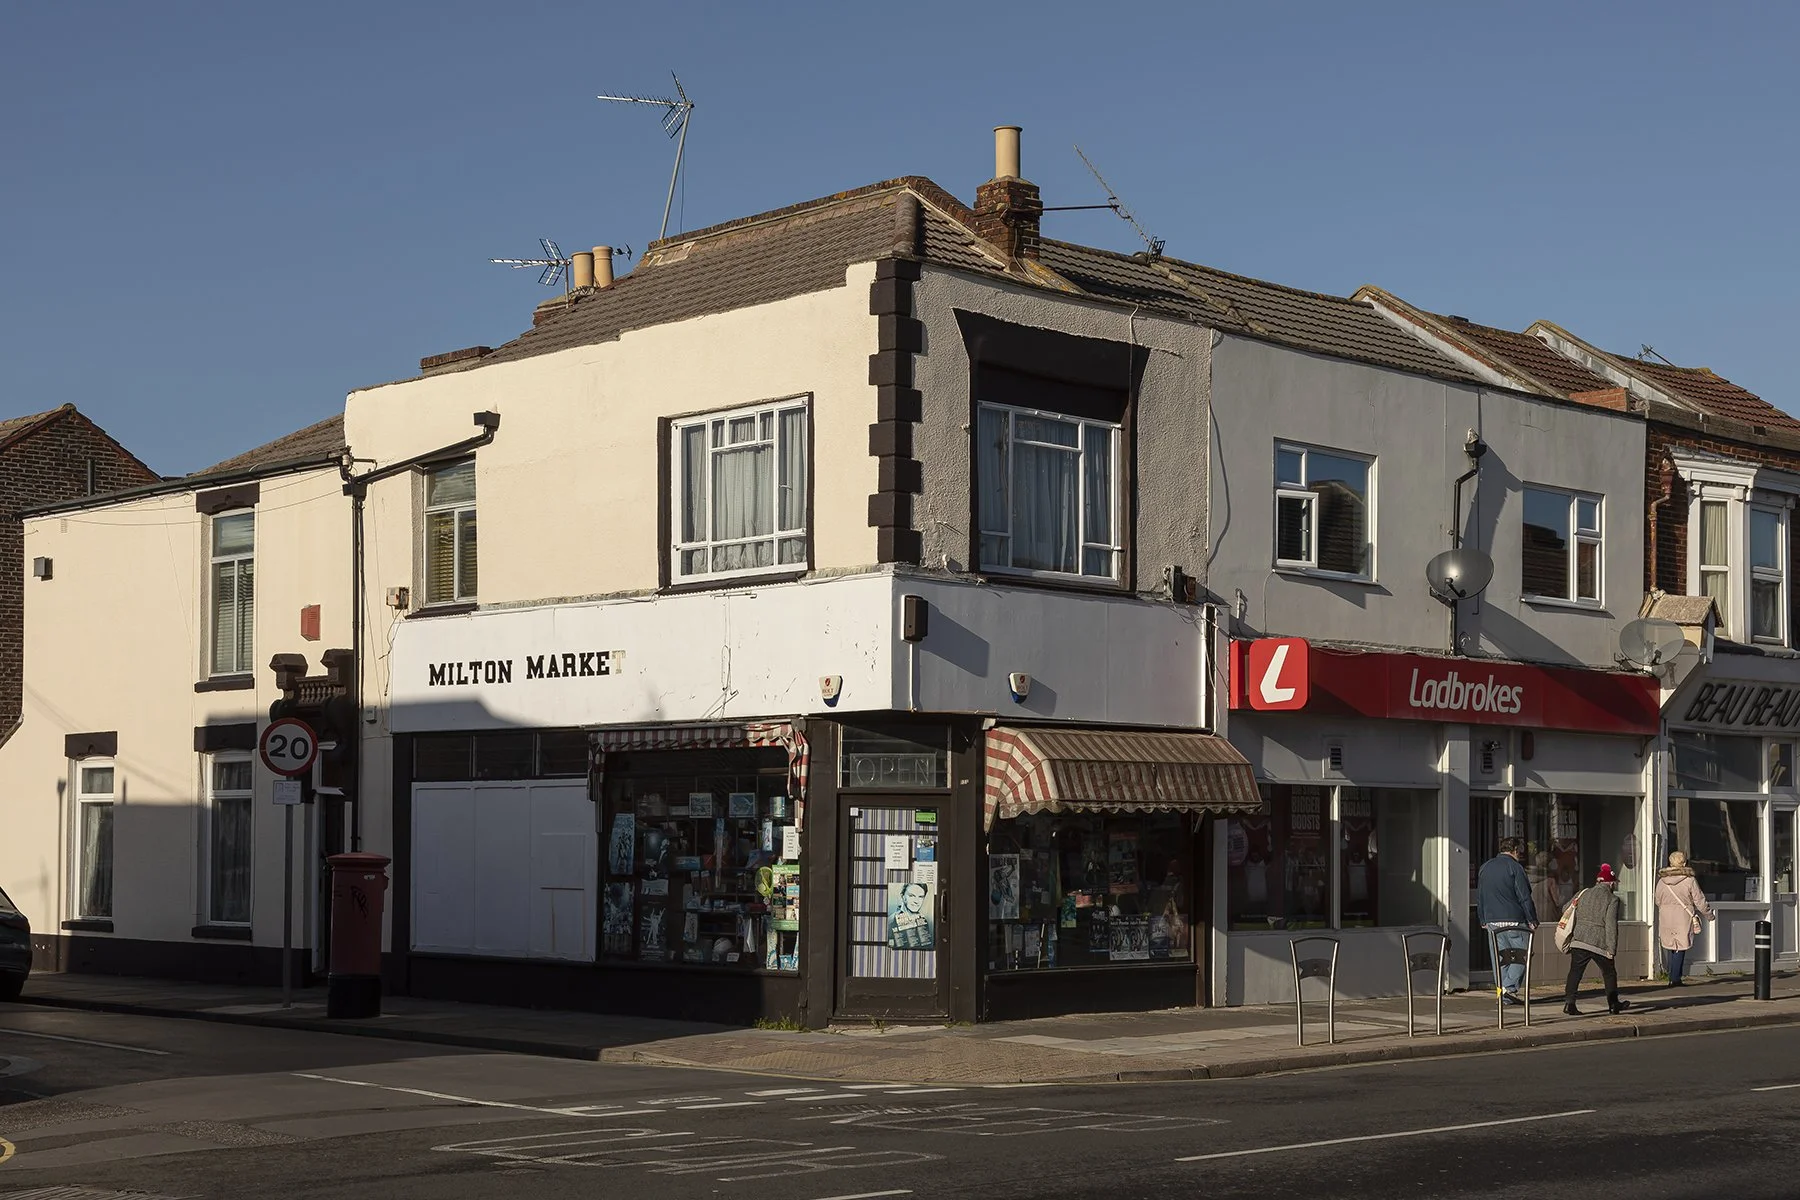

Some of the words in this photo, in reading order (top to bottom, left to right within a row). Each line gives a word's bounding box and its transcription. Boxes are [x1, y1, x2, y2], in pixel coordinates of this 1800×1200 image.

[428, 659, 513, 687] MILTON
[526, 649, 626, 680] MARKET
[1409, 667, 1523, 715] Ladbrokes
[1684, 682, 1755, 726] BEAU
[1742, 687, 1800, 729] BEAU
[269, 734, 309, 760] 20
[856, 757, 930, 785] OPEN
[1291, 795, 1321, 814] BIGGER
[1291, 813, 1321, 831] BOOSTS
[430, 1127, 947, 1182] CLEAR
